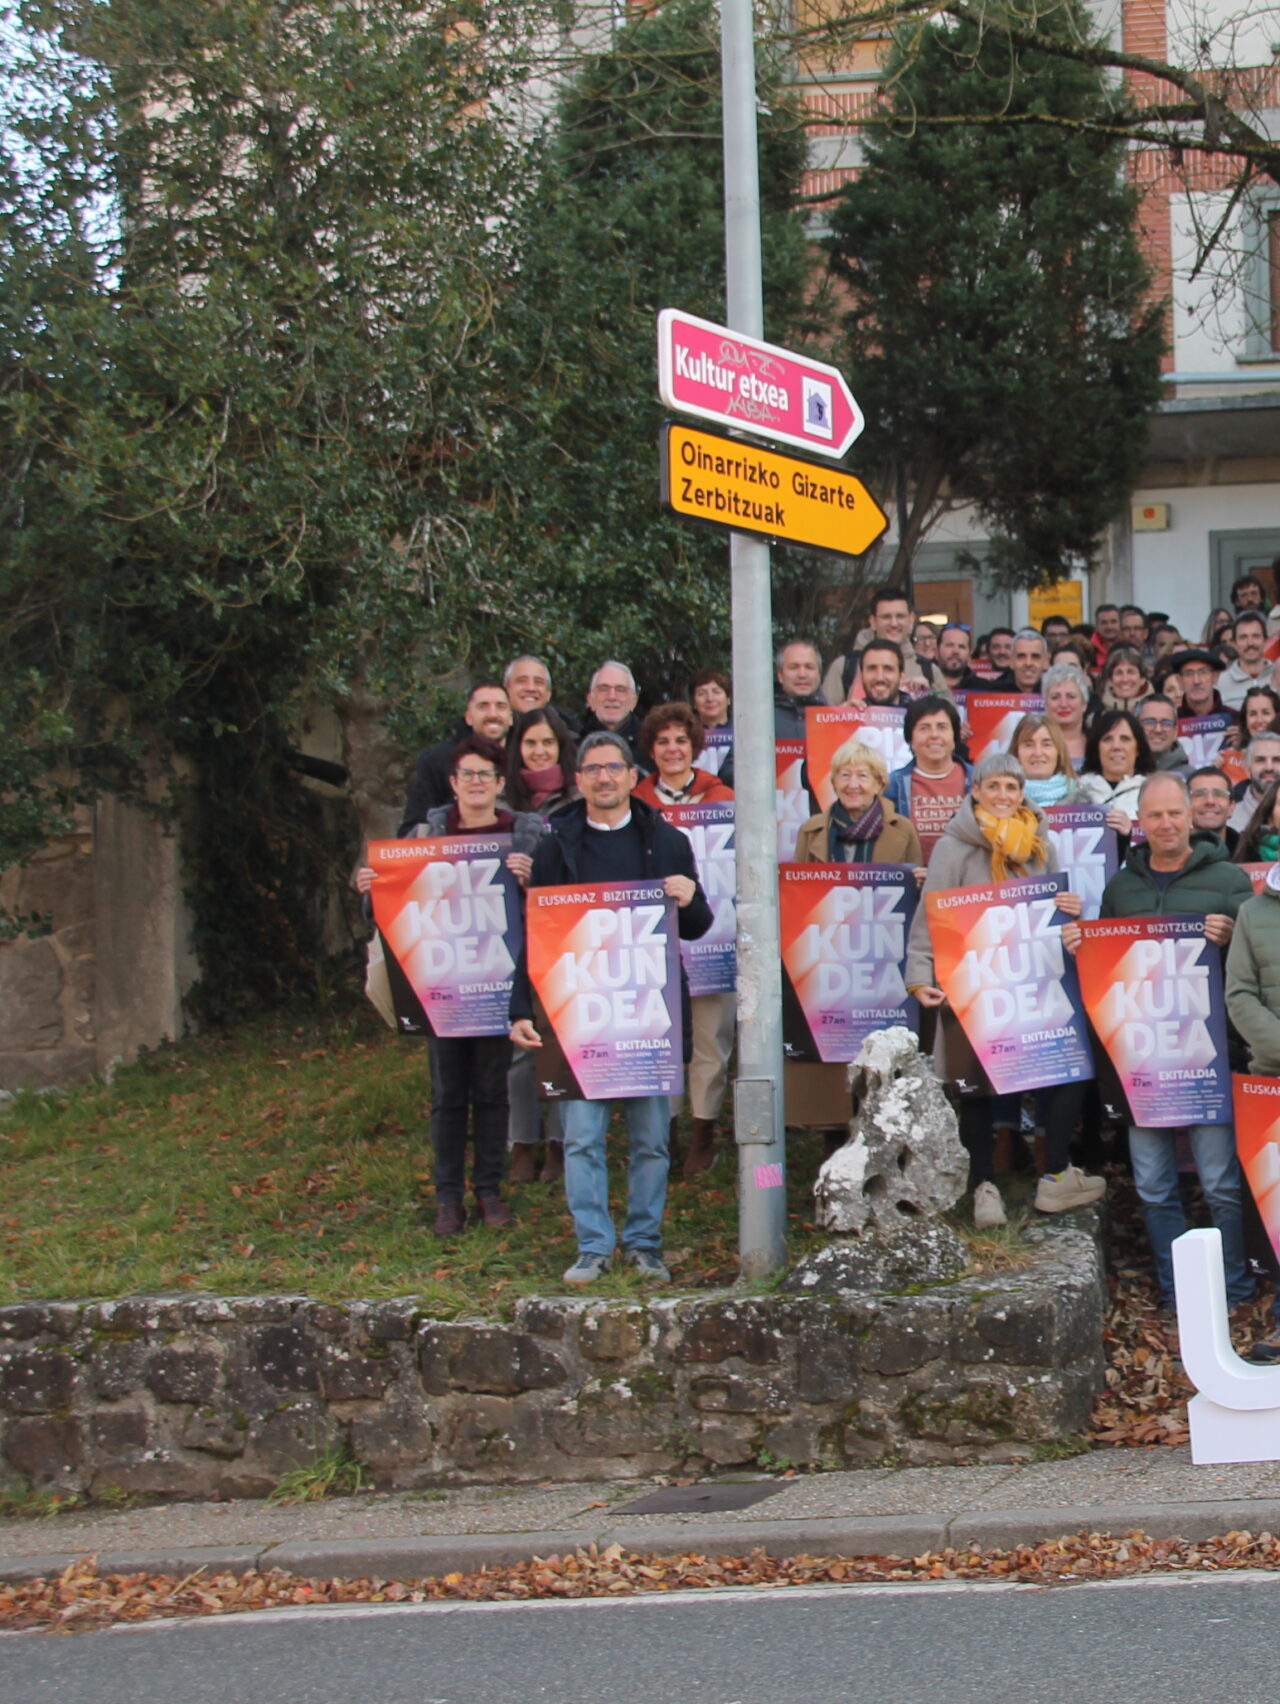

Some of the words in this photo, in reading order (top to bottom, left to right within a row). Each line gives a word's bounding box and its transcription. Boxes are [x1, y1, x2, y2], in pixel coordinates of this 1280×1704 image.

[676, 344, 737, 392] Kultur
[740, 376, 788, 411] etxea
[681, 441, 780, 489] Oinarrizko
[792, 473, 854, 510] Gizarte
[681, 478, 785, 526] Zerbitzuak
[680, 808, 734, 821] BIZITZEKO
[1047, 811, 1104, 824] BIZITZEKO
[380, 847, 436, 859] EUSKARAZ
[442, 842, 499, 855] BIZITZEKO
[428, 859, 505, 896] PIZ
[786, 871, 841, 881] EUSKARAZ
[848, 871, 904, 882] BIZITZEKO
[937, 891, 993, 909] EUSKARAZ
[1000, 882, 1057, 899] BIZITZEKO
[538, 892, 596, 906] EUSKARAZ
[603, 888, 664, 902] BIZITZEKO
[831, 886, 906, 922] PIZ
[408, 896, 508, 938] KUN
[587, 905, 667, 947] PIZ
[987, 898, 1062, 943] PIZ
[1084, 925, 1141, 937] EUSKARAZ
[1148, 923, 1204, 934] BIZITZEKO
[421, 935, 516, 976] DEA
[690, 943, 737, 955] EKITALDI
[808, 923, 905, 962] KUN
[1134, 938, 1209, 978] PIZ
[564, 947, 667, 989] KUN
[819, 963, 908, 1000] DEA
[966, 940, 1065, 988] KUN
[578, 989, 672, 1032] DEA
[852, 1009, 907, 1019] EKITALDIA
[980, 980, 1075, 1027] DEA
[1113, 978, 1211, 1020] KUN
[616, 1039, 671, 1050] EKITALDIA
[1021, 1026, 1077, 1044] EKITALDIA
[1123, 1020, 1217, 1061] DEA
[1158, 1069, 1217, 1080] EKITALDIA
